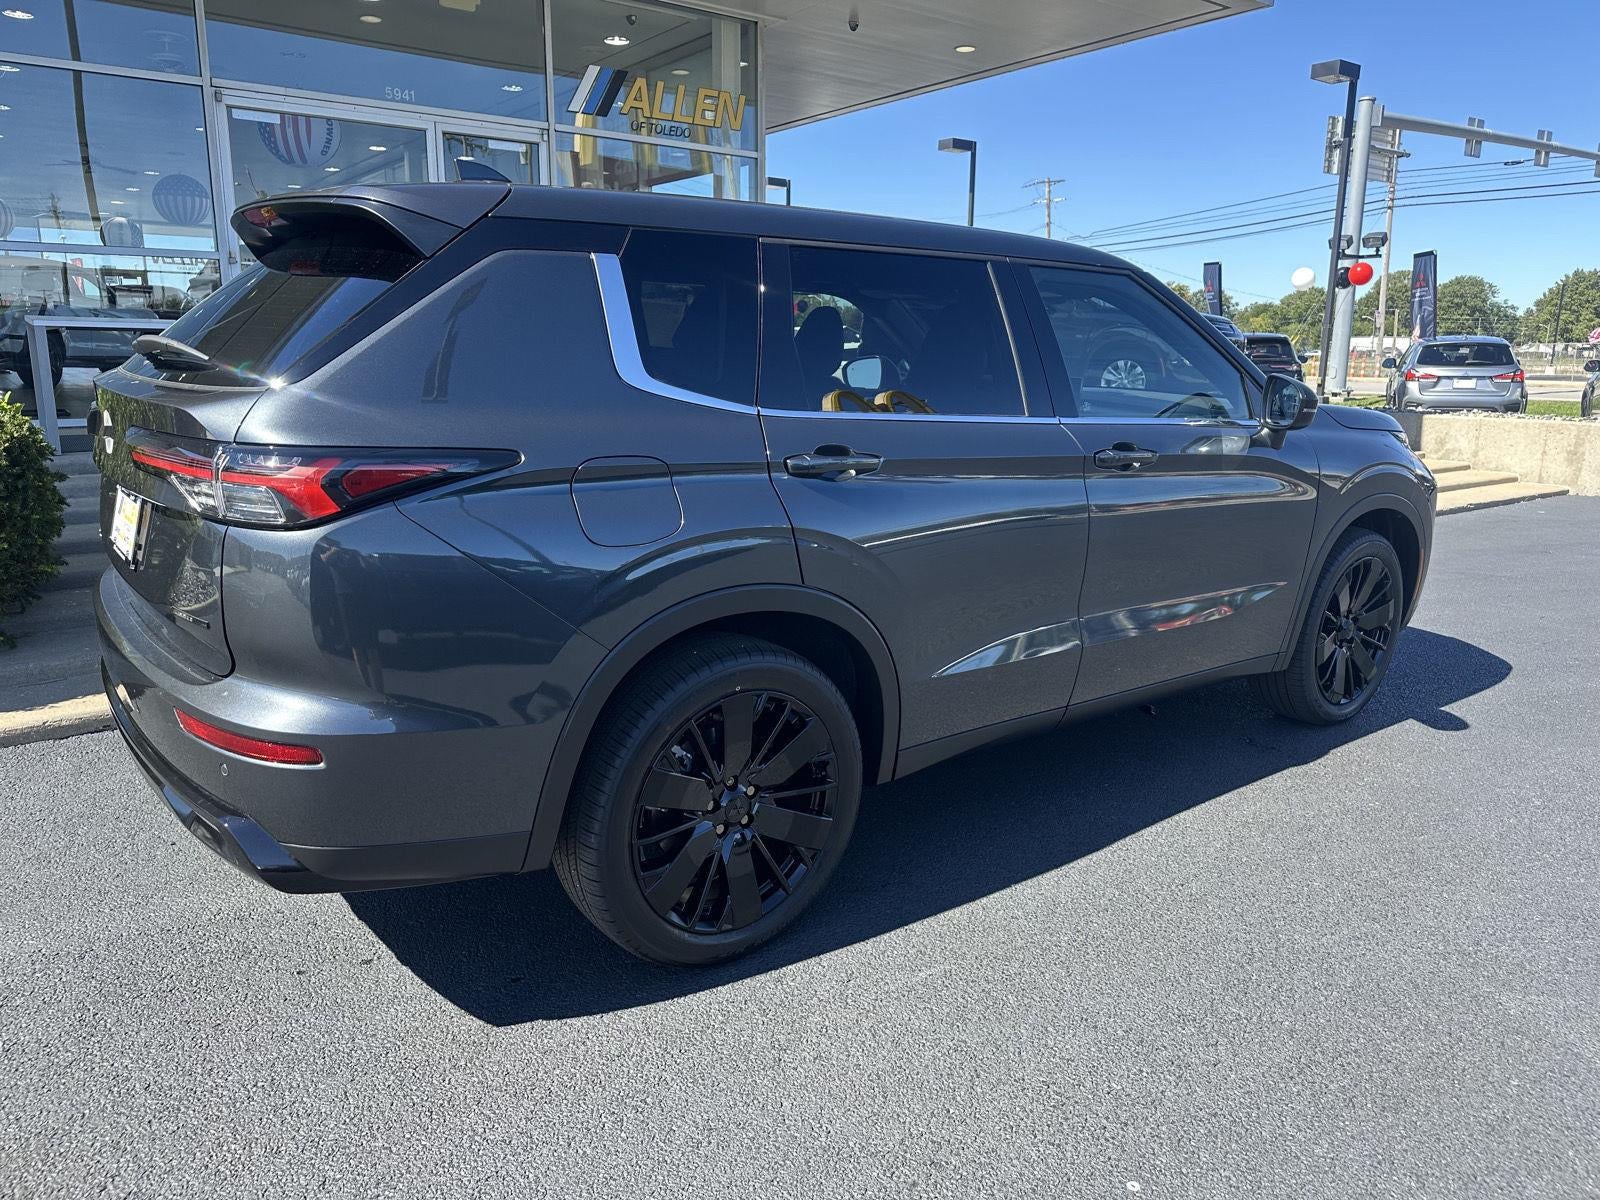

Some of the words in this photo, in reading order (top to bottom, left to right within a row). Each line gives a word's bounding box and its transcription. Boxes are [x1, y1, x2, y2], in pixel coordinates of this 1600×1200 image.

[385, 86, 415, 102] 5941
[619, 76, 746, 131] ALLEN
[630, 119, 647, 132] OF
[649, 122, 692, 139] TOLEDO
